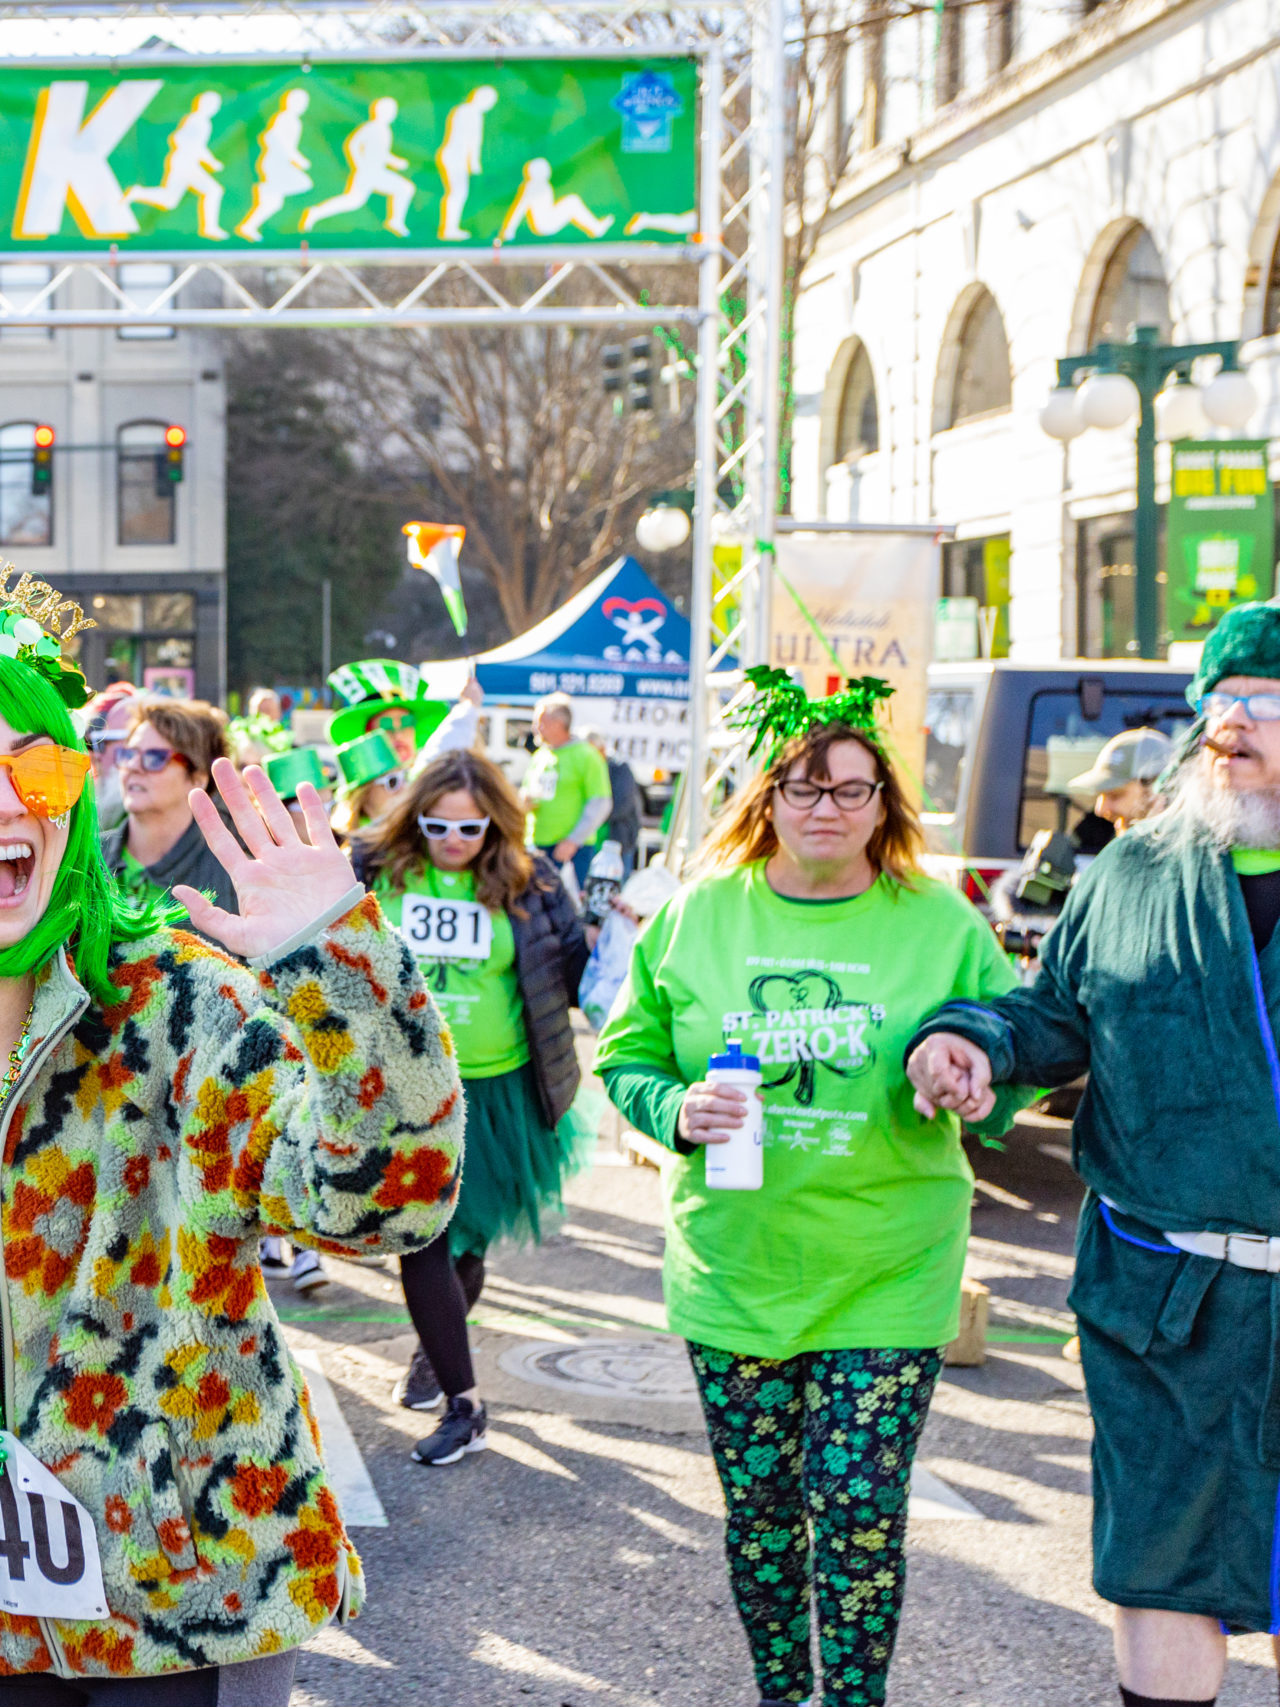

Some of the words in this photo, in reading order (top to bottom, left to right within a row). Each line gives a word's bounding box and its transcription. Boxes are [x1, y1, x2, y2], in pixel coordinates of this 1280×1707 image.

[12, 79, 165, 241] K
[775, 632, 907, 668] ULTRA
[410, 904, 480, 945] 381
[722, 1010, 761, 1032] ST.
[765, 1003, 887, 1030] PATRICK'S
[751, 1021, 871, 1065] ZERO-K
